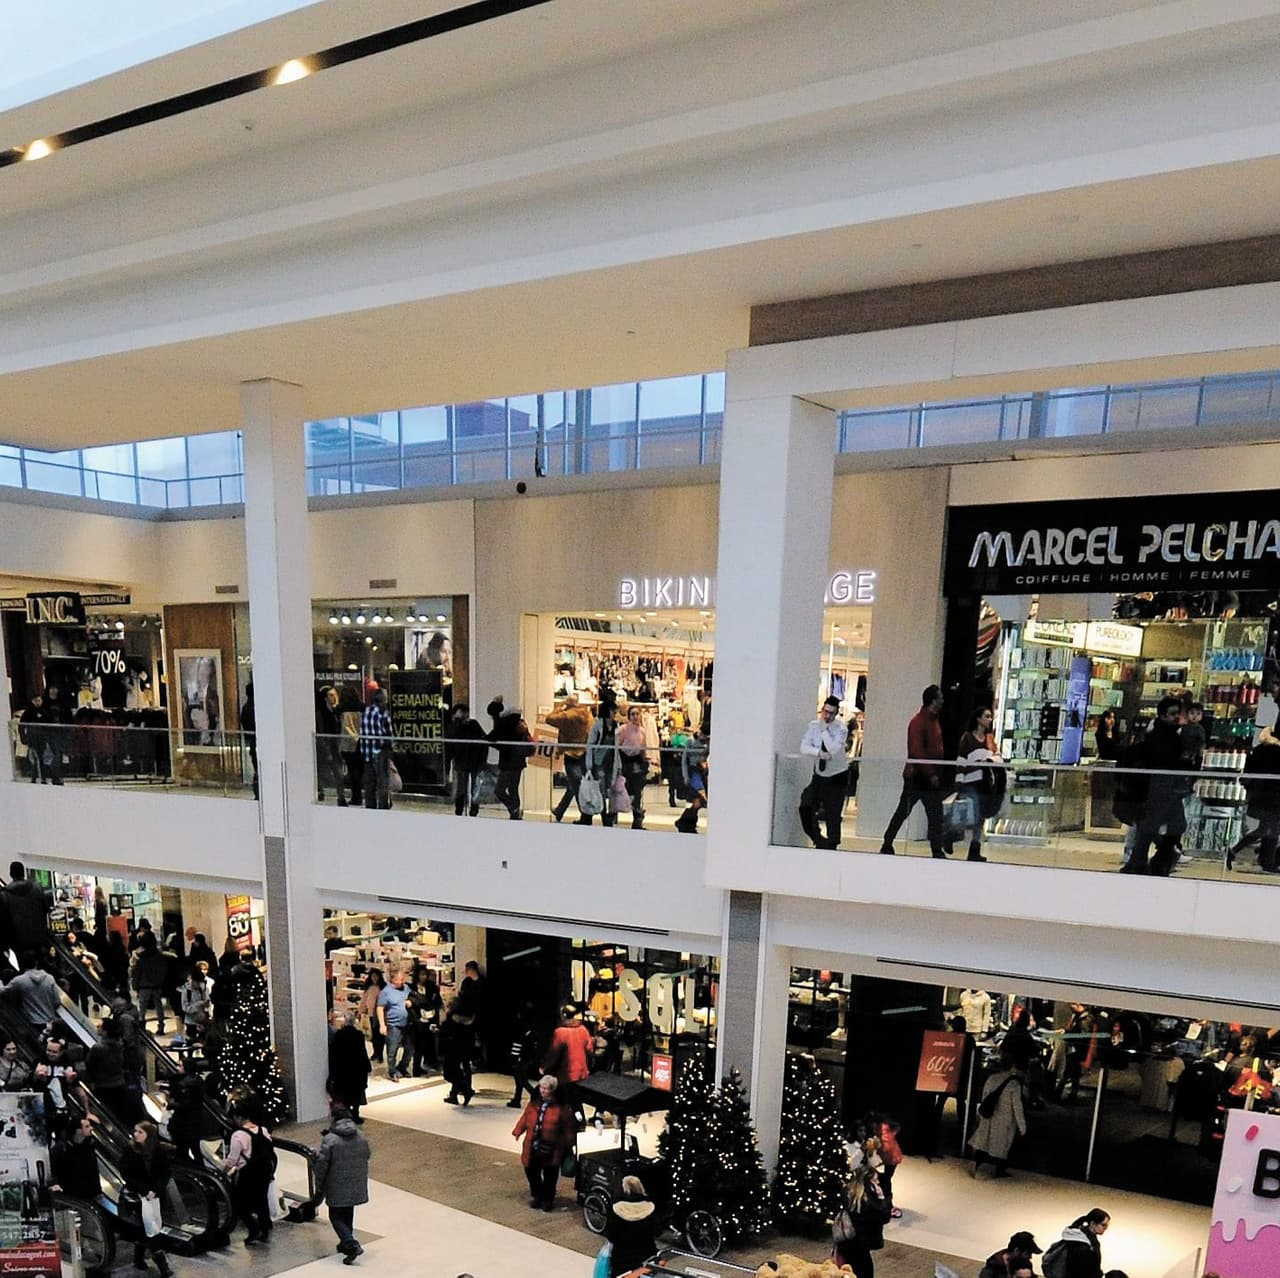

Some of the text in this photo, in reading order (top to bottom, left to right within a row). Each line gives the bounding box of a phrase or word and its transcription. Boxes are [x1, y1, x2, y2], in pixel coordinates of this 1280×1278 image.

[968, 527, 1123, 568] MARCEL
[1015, 569, 1251, 585] COIFFURE HOMME FEMME
[621, 577, 709, 607] BIKIN
[92, 650, 126, 674] 70%
[392, 693, 441, 707] SEMAINE
[393, 722, 441, 740] VENTE
[926, 1055, 957, 1072] 60%
